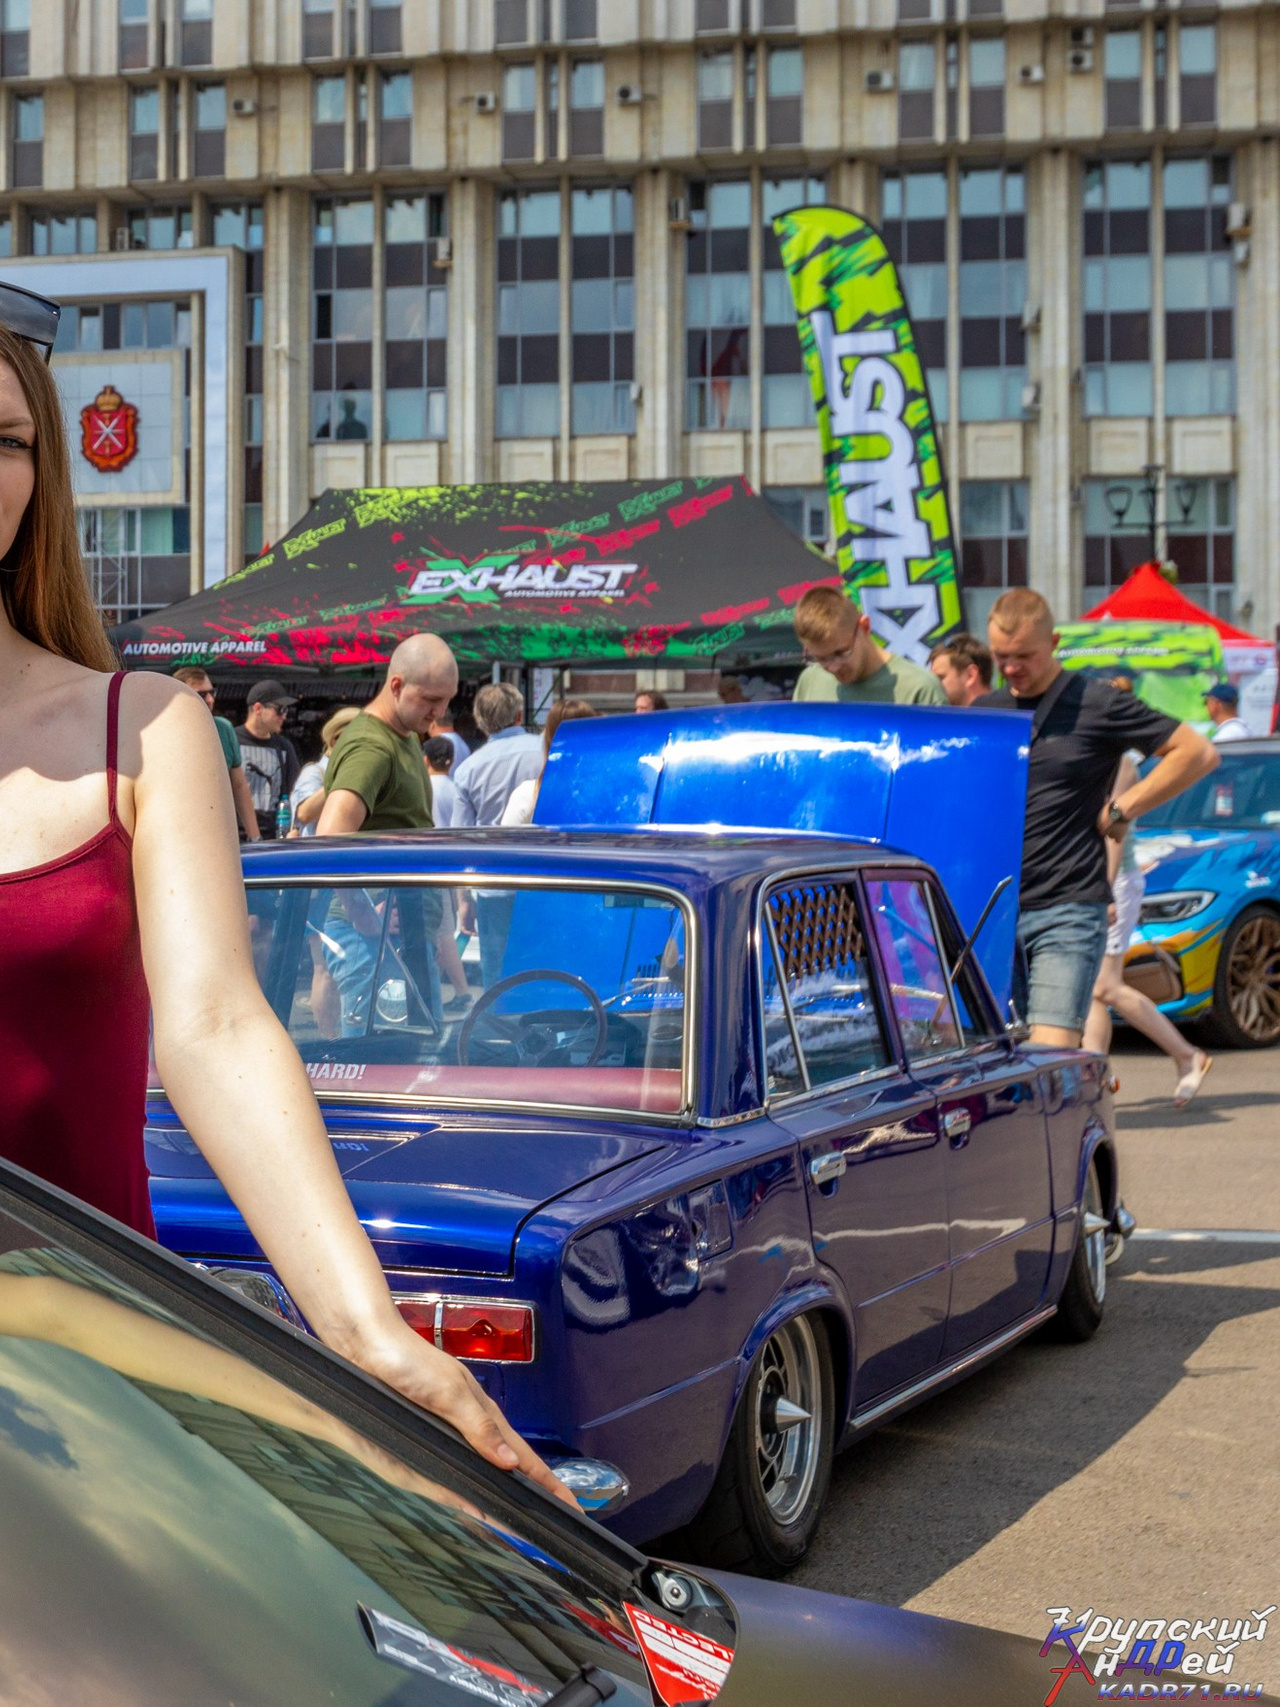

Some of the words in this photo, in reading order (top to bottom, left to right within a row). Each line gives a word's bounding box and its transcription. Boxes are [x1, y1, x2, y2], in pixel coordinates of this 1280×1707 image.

[810, 310, 941, 668] XHAUST
[403, 555, 639, 604] EXHAUST
[123, 642, 208, 656] AUTOMOTIVE
[210, 640, 267, 653] APPAREL
[306, 1063, 366, 1079] HARD!
